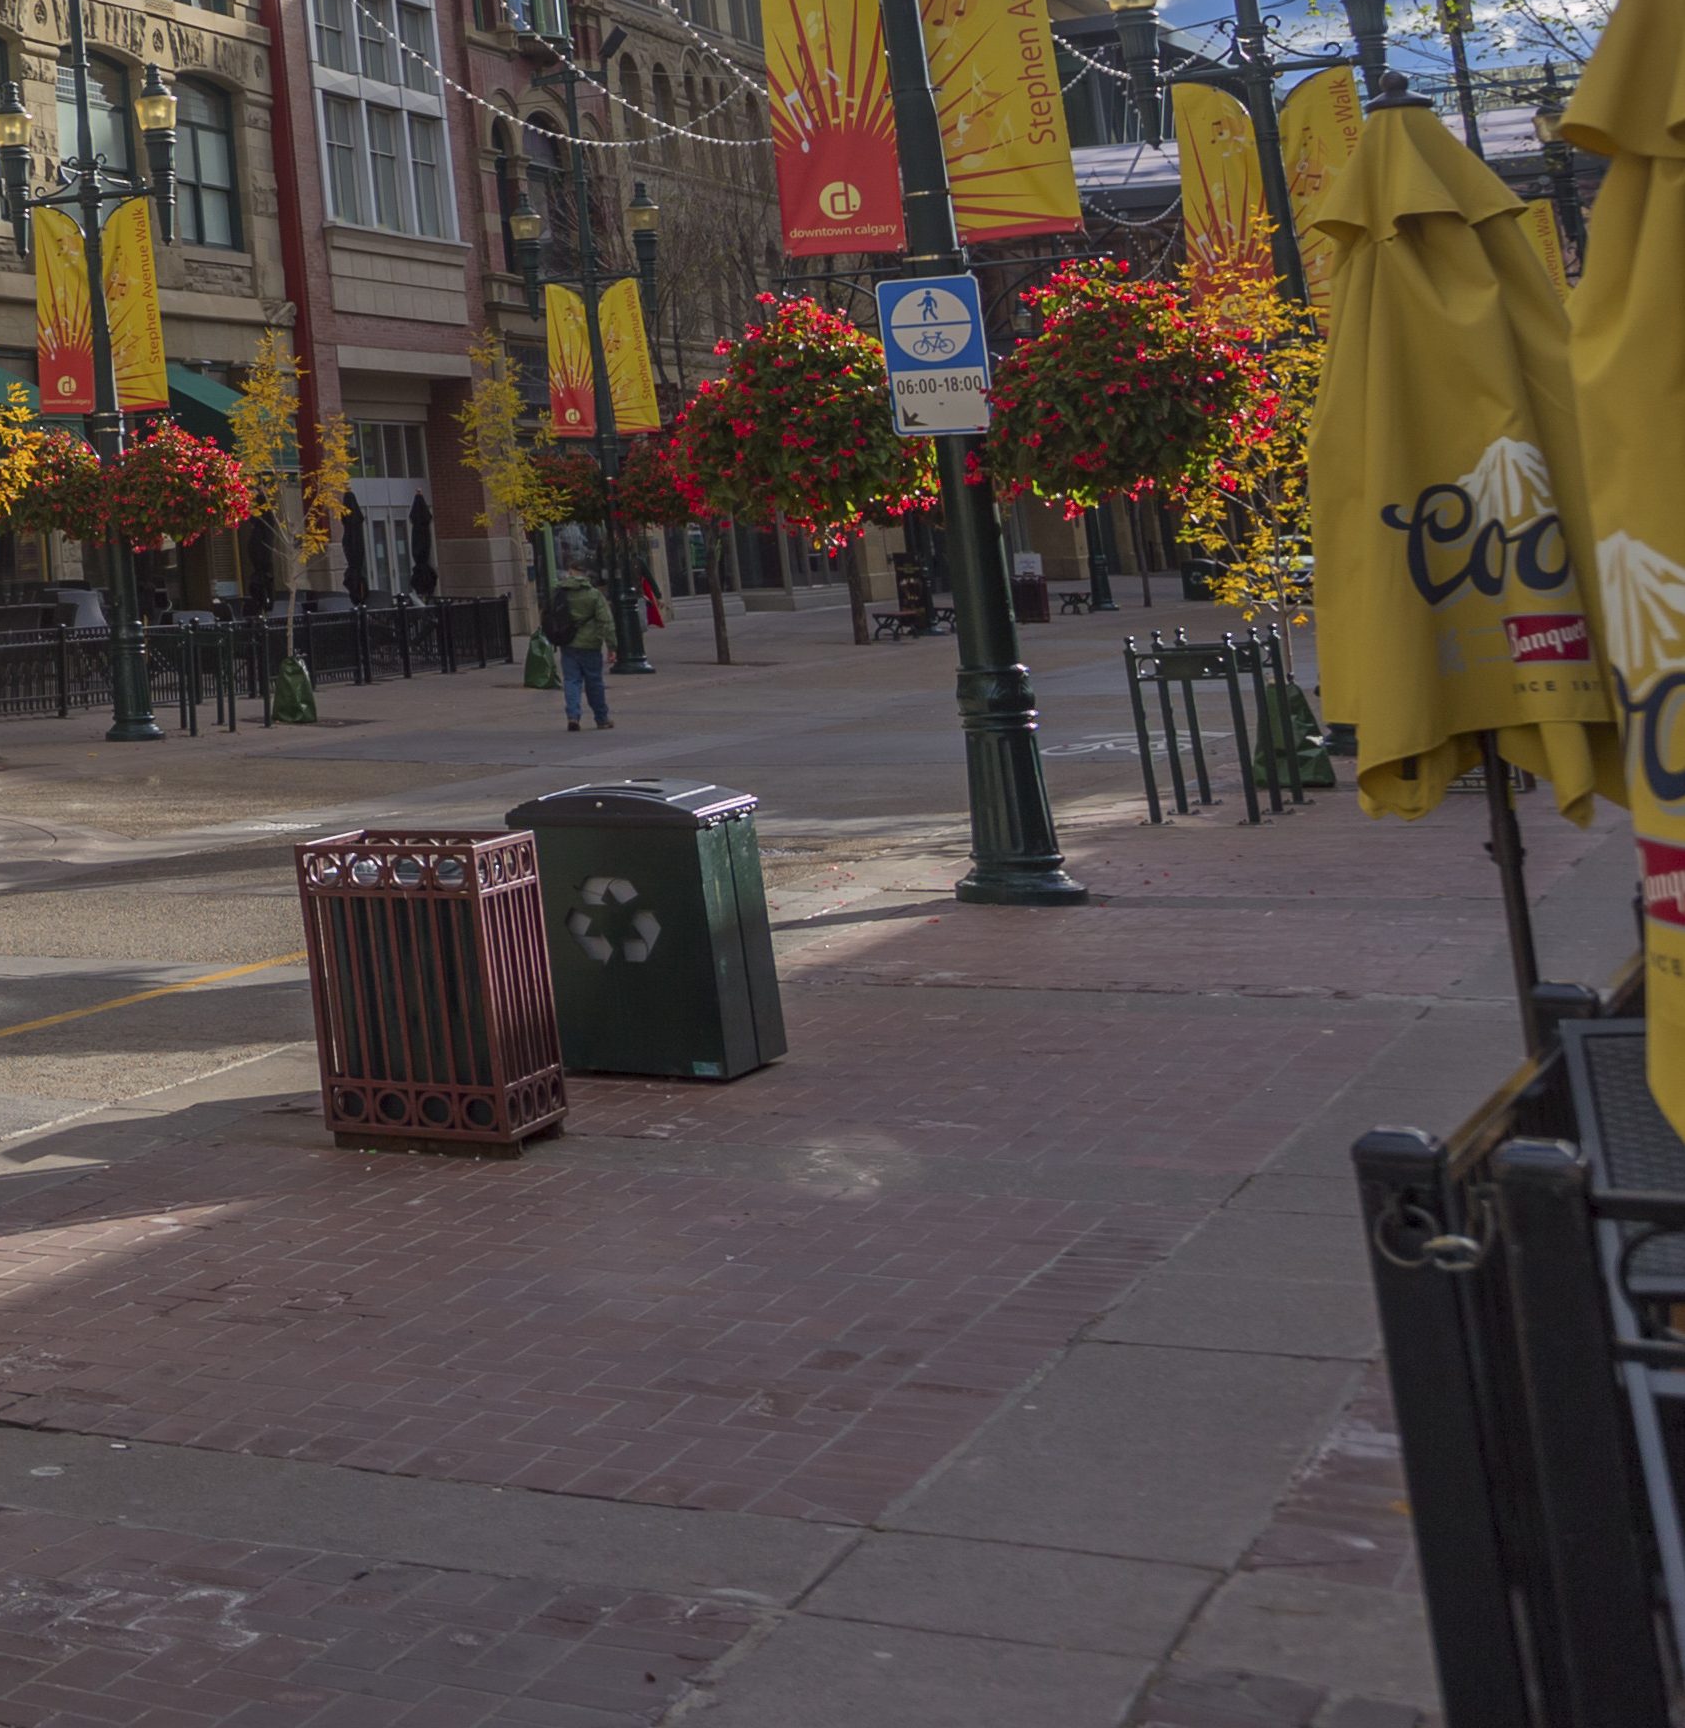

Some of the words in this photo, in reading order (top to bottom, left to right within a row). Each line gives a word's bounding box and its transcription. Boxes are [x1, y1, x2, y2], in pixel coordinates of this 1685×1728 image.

[1017, 26, 1058, 145] Stephen
[1328, 77, 1353, 125] Walk
[132, 207, 147, 243] Walk
[789, 226, 852, 240] downtown
[854, 223, 897, 239] calgary
[137, 246, 154, 298] Avenue
[145, 303, 161, 364] Stephen
[896, 374, 982, 397] 06:00-18:00
[1380, 483, 1574, 606] Coo
